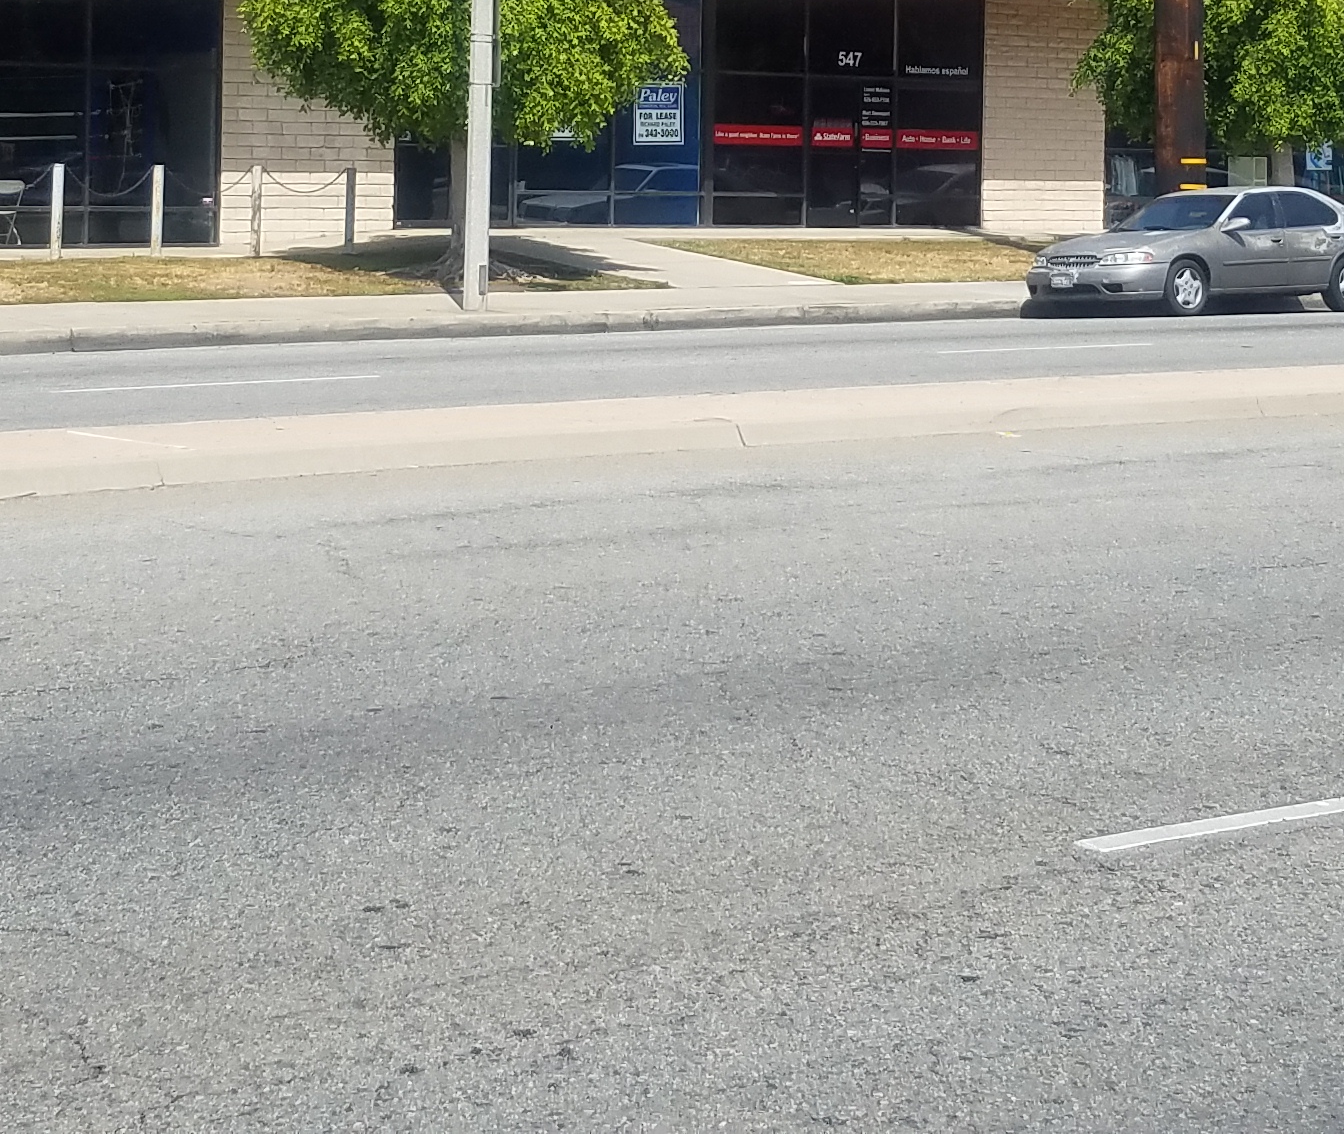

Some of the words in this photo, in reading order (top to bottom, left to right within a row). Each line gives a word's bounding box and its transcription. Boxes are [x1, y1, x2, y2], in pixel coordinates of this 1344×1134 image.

[837, 51, 863, 67] 547
[905, 65, 940, 75] Hablamos
[941, 66, 969, 77] español
[639, 88, 678, 104] Paley
[639, 112, 653, 120] FOR
[655, 112, 677, 120] LEASE
